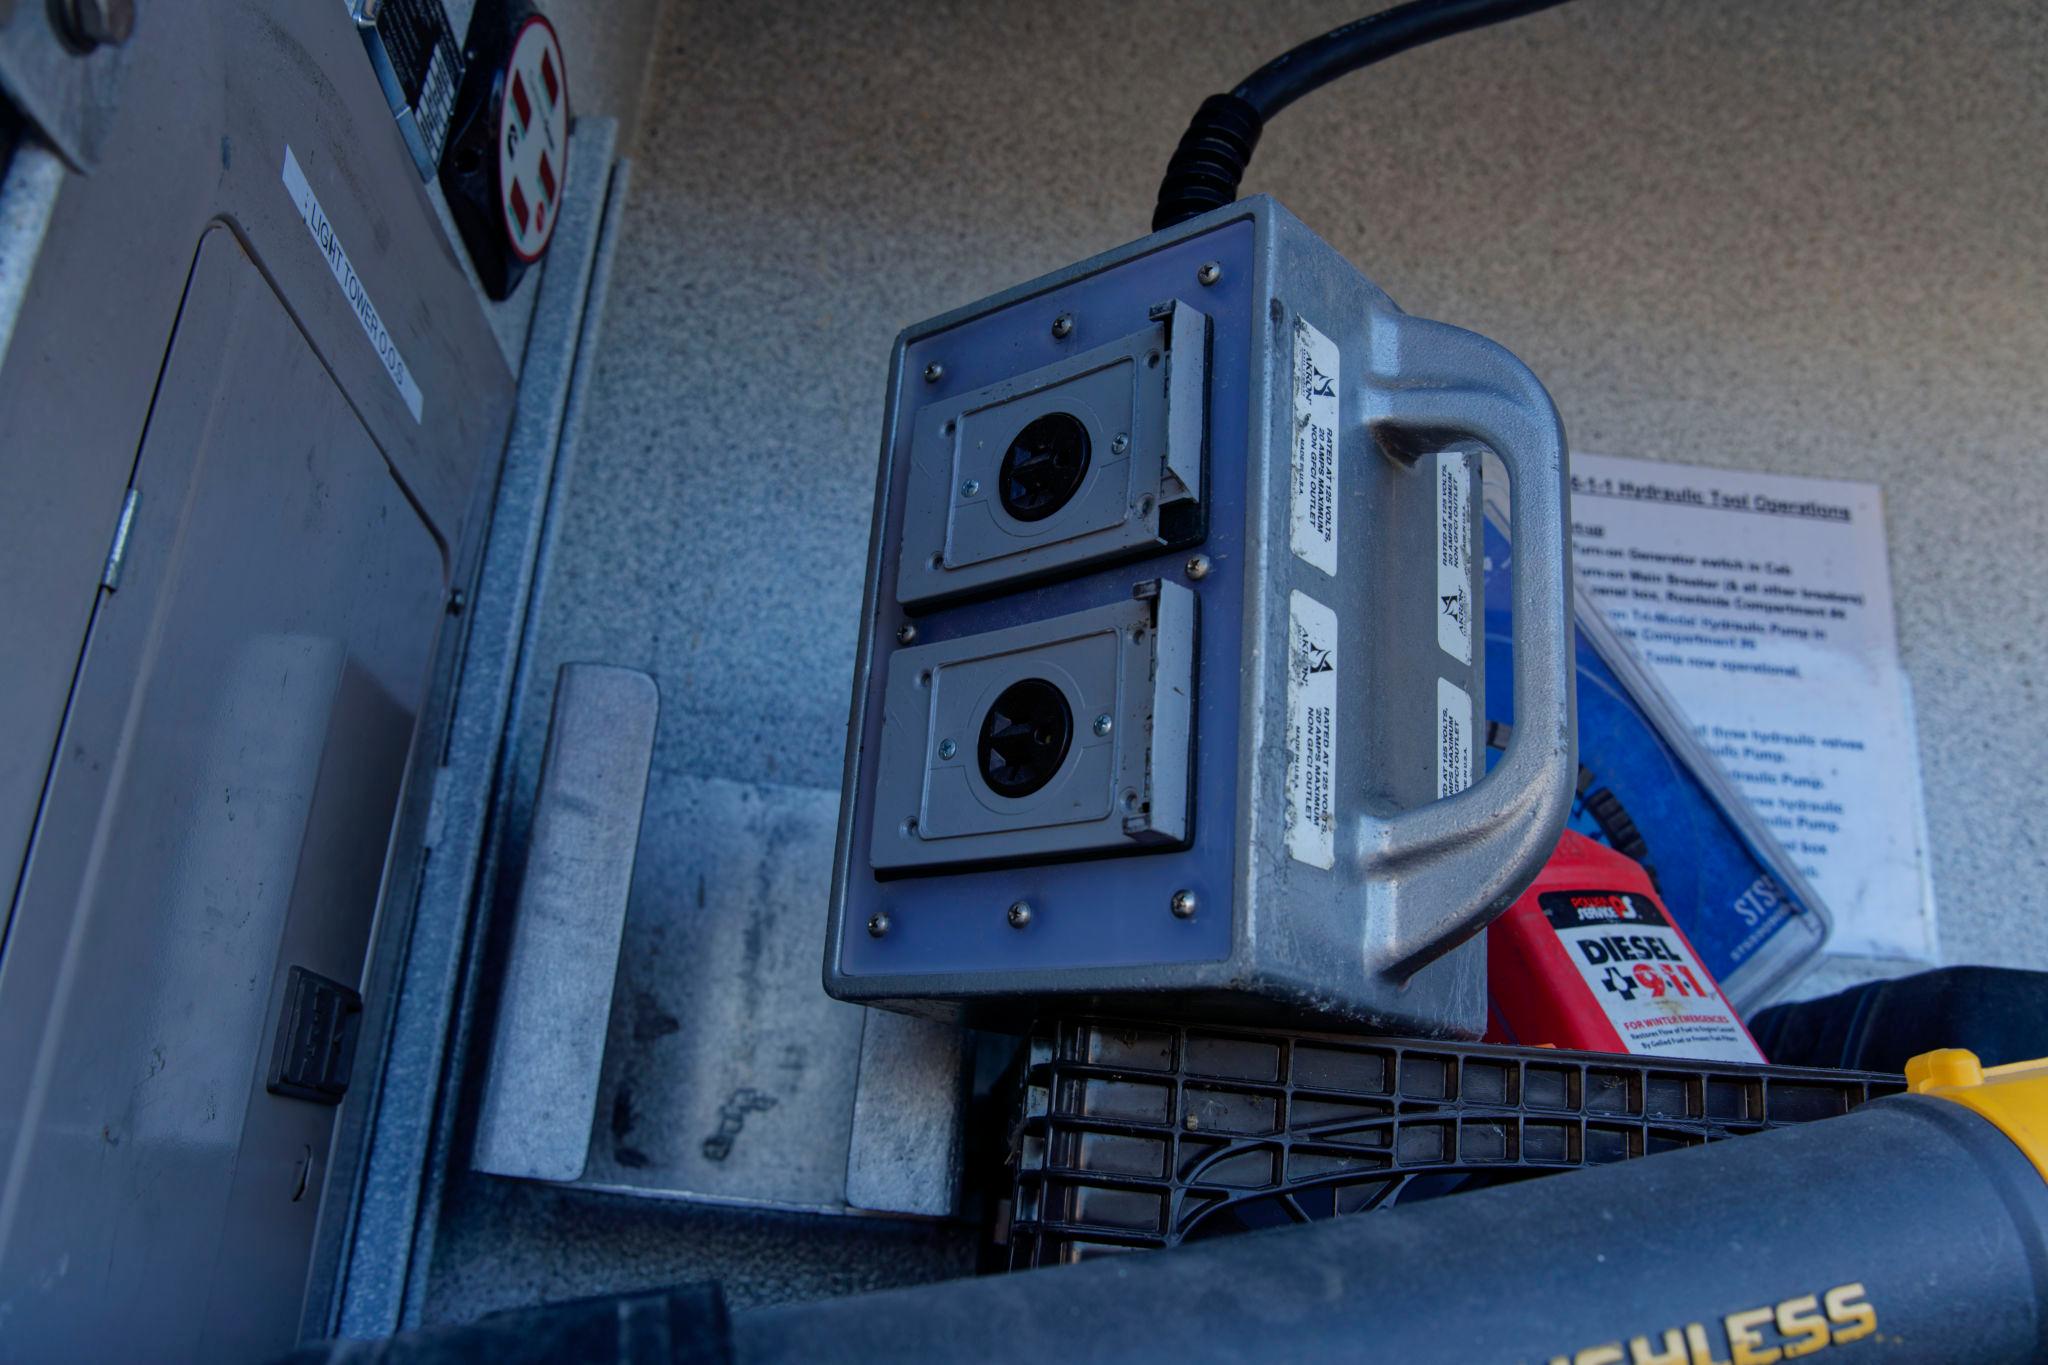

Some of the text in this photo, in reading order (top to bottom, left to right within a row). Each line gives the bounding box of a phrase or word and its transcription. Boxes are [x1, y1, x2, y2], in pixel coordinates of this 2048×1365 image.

[311, 203, 343, 272] LIGHT
[344, 262, 378, 341] TOWER
[1318, 427, 1325, 441] 20
[1325, 467, 1332, 482] AT
[1309, 481, 1317, 528] OUTLET
[1317, 477, 1325, 533] MAXIMUM
[1619, 480, 1704, 505] Hydraulic
[1710, 489, 1749, 509] Tool
[1754, 495, 1852, 521] Operations
[1324, 505, 1332, 542] VOLTS,
[1628, 546, 1696, 565] Generator
[1734, 597, 1825, 616] Compartment
[1642, 627, 1735, 648] Compartment
[1315, 708, 1322, 723] 20
[1323, 751, 1329, 767] AT
[1305, 771, 1313, 821] OUTLET
[1313, 765, 1321, 826] MAXIMUM
[1576, 935, 1683, 965] DIESEL
[1623, 1014, 1730, 1032] FOR WINTER EMERGENCIES
